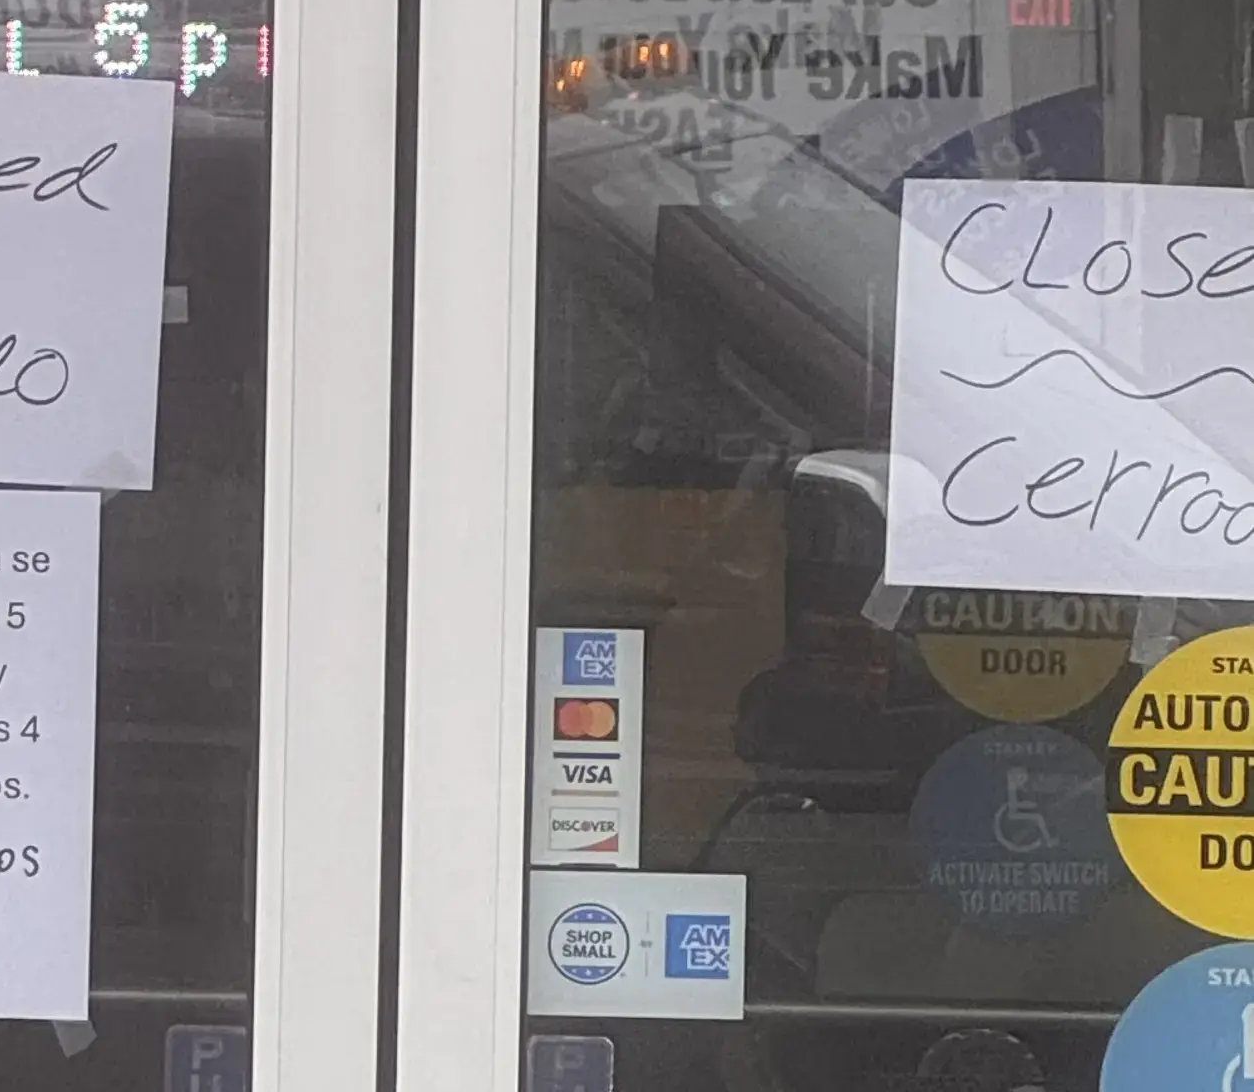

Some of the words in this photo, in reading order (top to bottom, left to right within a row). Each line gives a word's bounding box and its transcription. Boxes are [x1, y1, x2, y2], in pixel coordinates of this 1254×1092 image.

[12, 551, 50, 573] se
[7, 602, 26, 629] 5
[981, 648, 1067, 677] DOOR
[20, 715, 40, 743] 4
[562, 765, 613, 785] VISA
[1119, 753, 1254, 807] CAU
[552, 819, 616, 833] DISCOVER
[929, 861, 1026, 886] ACTIVATE
[1030, 862, 1110, 886] SWITCH
[566, 929, 613, 945] SHOP
[561, 943, 617, 960] SMALL
